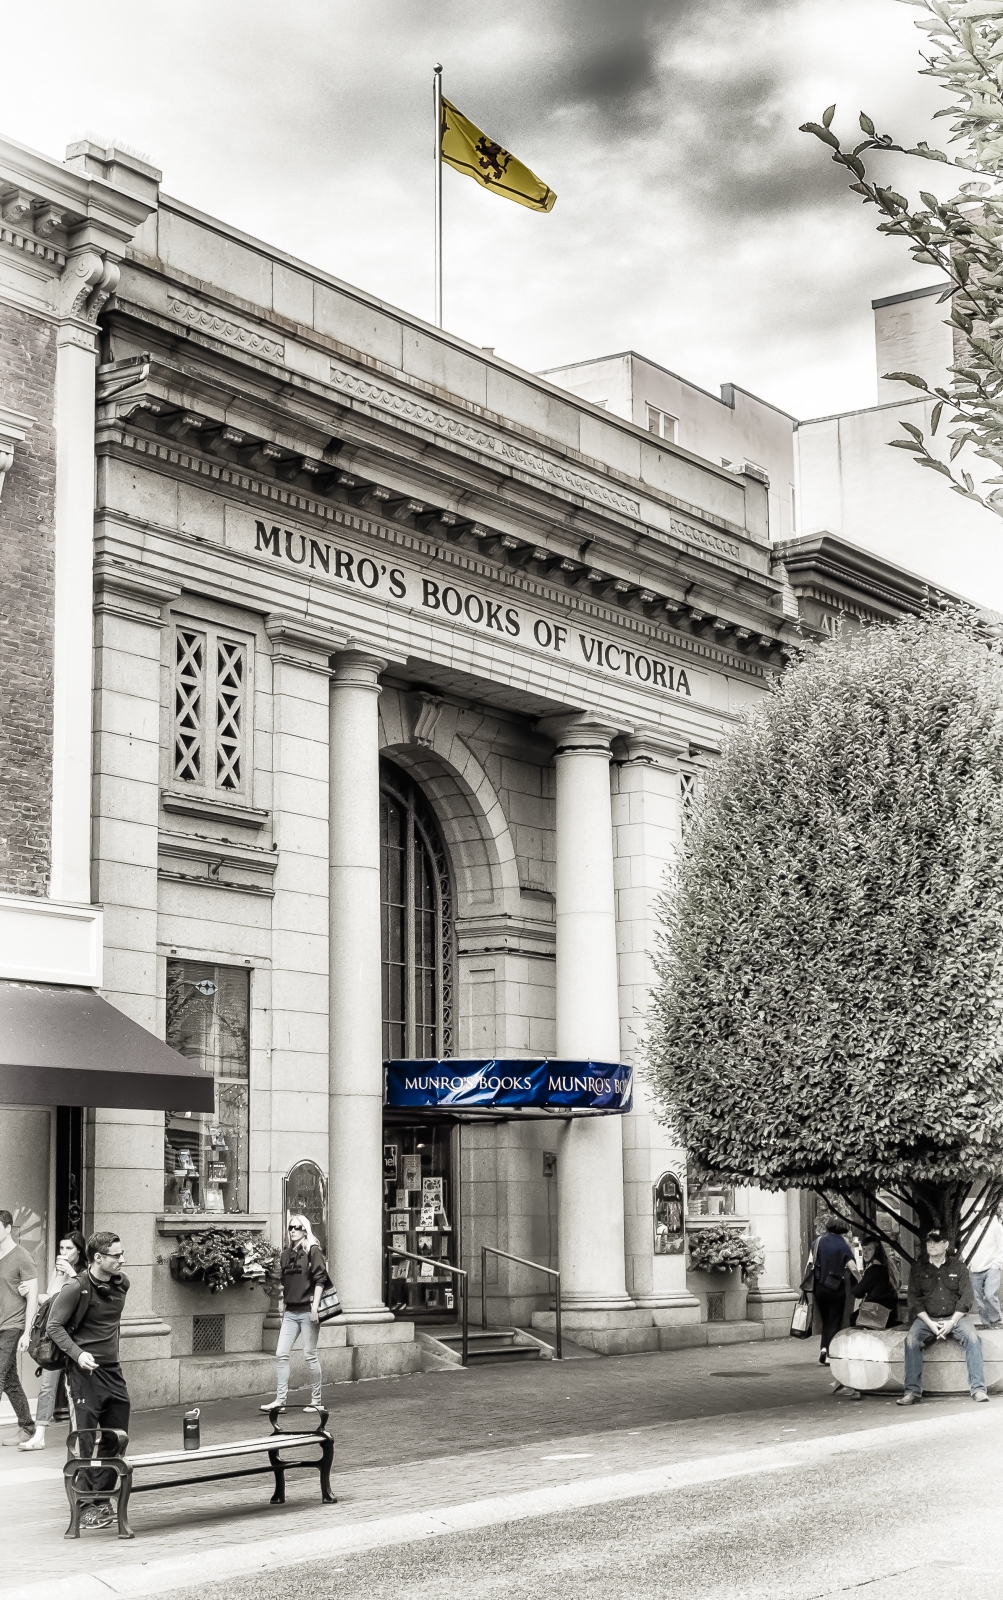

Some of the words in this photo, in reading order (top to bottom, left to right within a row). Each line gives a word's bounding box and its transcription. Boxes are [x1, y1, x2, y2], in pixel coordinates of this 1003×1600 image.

[254, 520, 407, 599] MUNRO'S
[421, 578, 521, 637] BOOKS
[533, 619, 568, 652] OF
[578, 634, 692, 696] VICTORIA
[405, 1076, 473, 1092] MUNRO'S
[479, 1076, 532, 1090] BOOKS
[548, 1074, 611, 1096] MUNRO'S
[614, 1078, 627, 1095] BO
